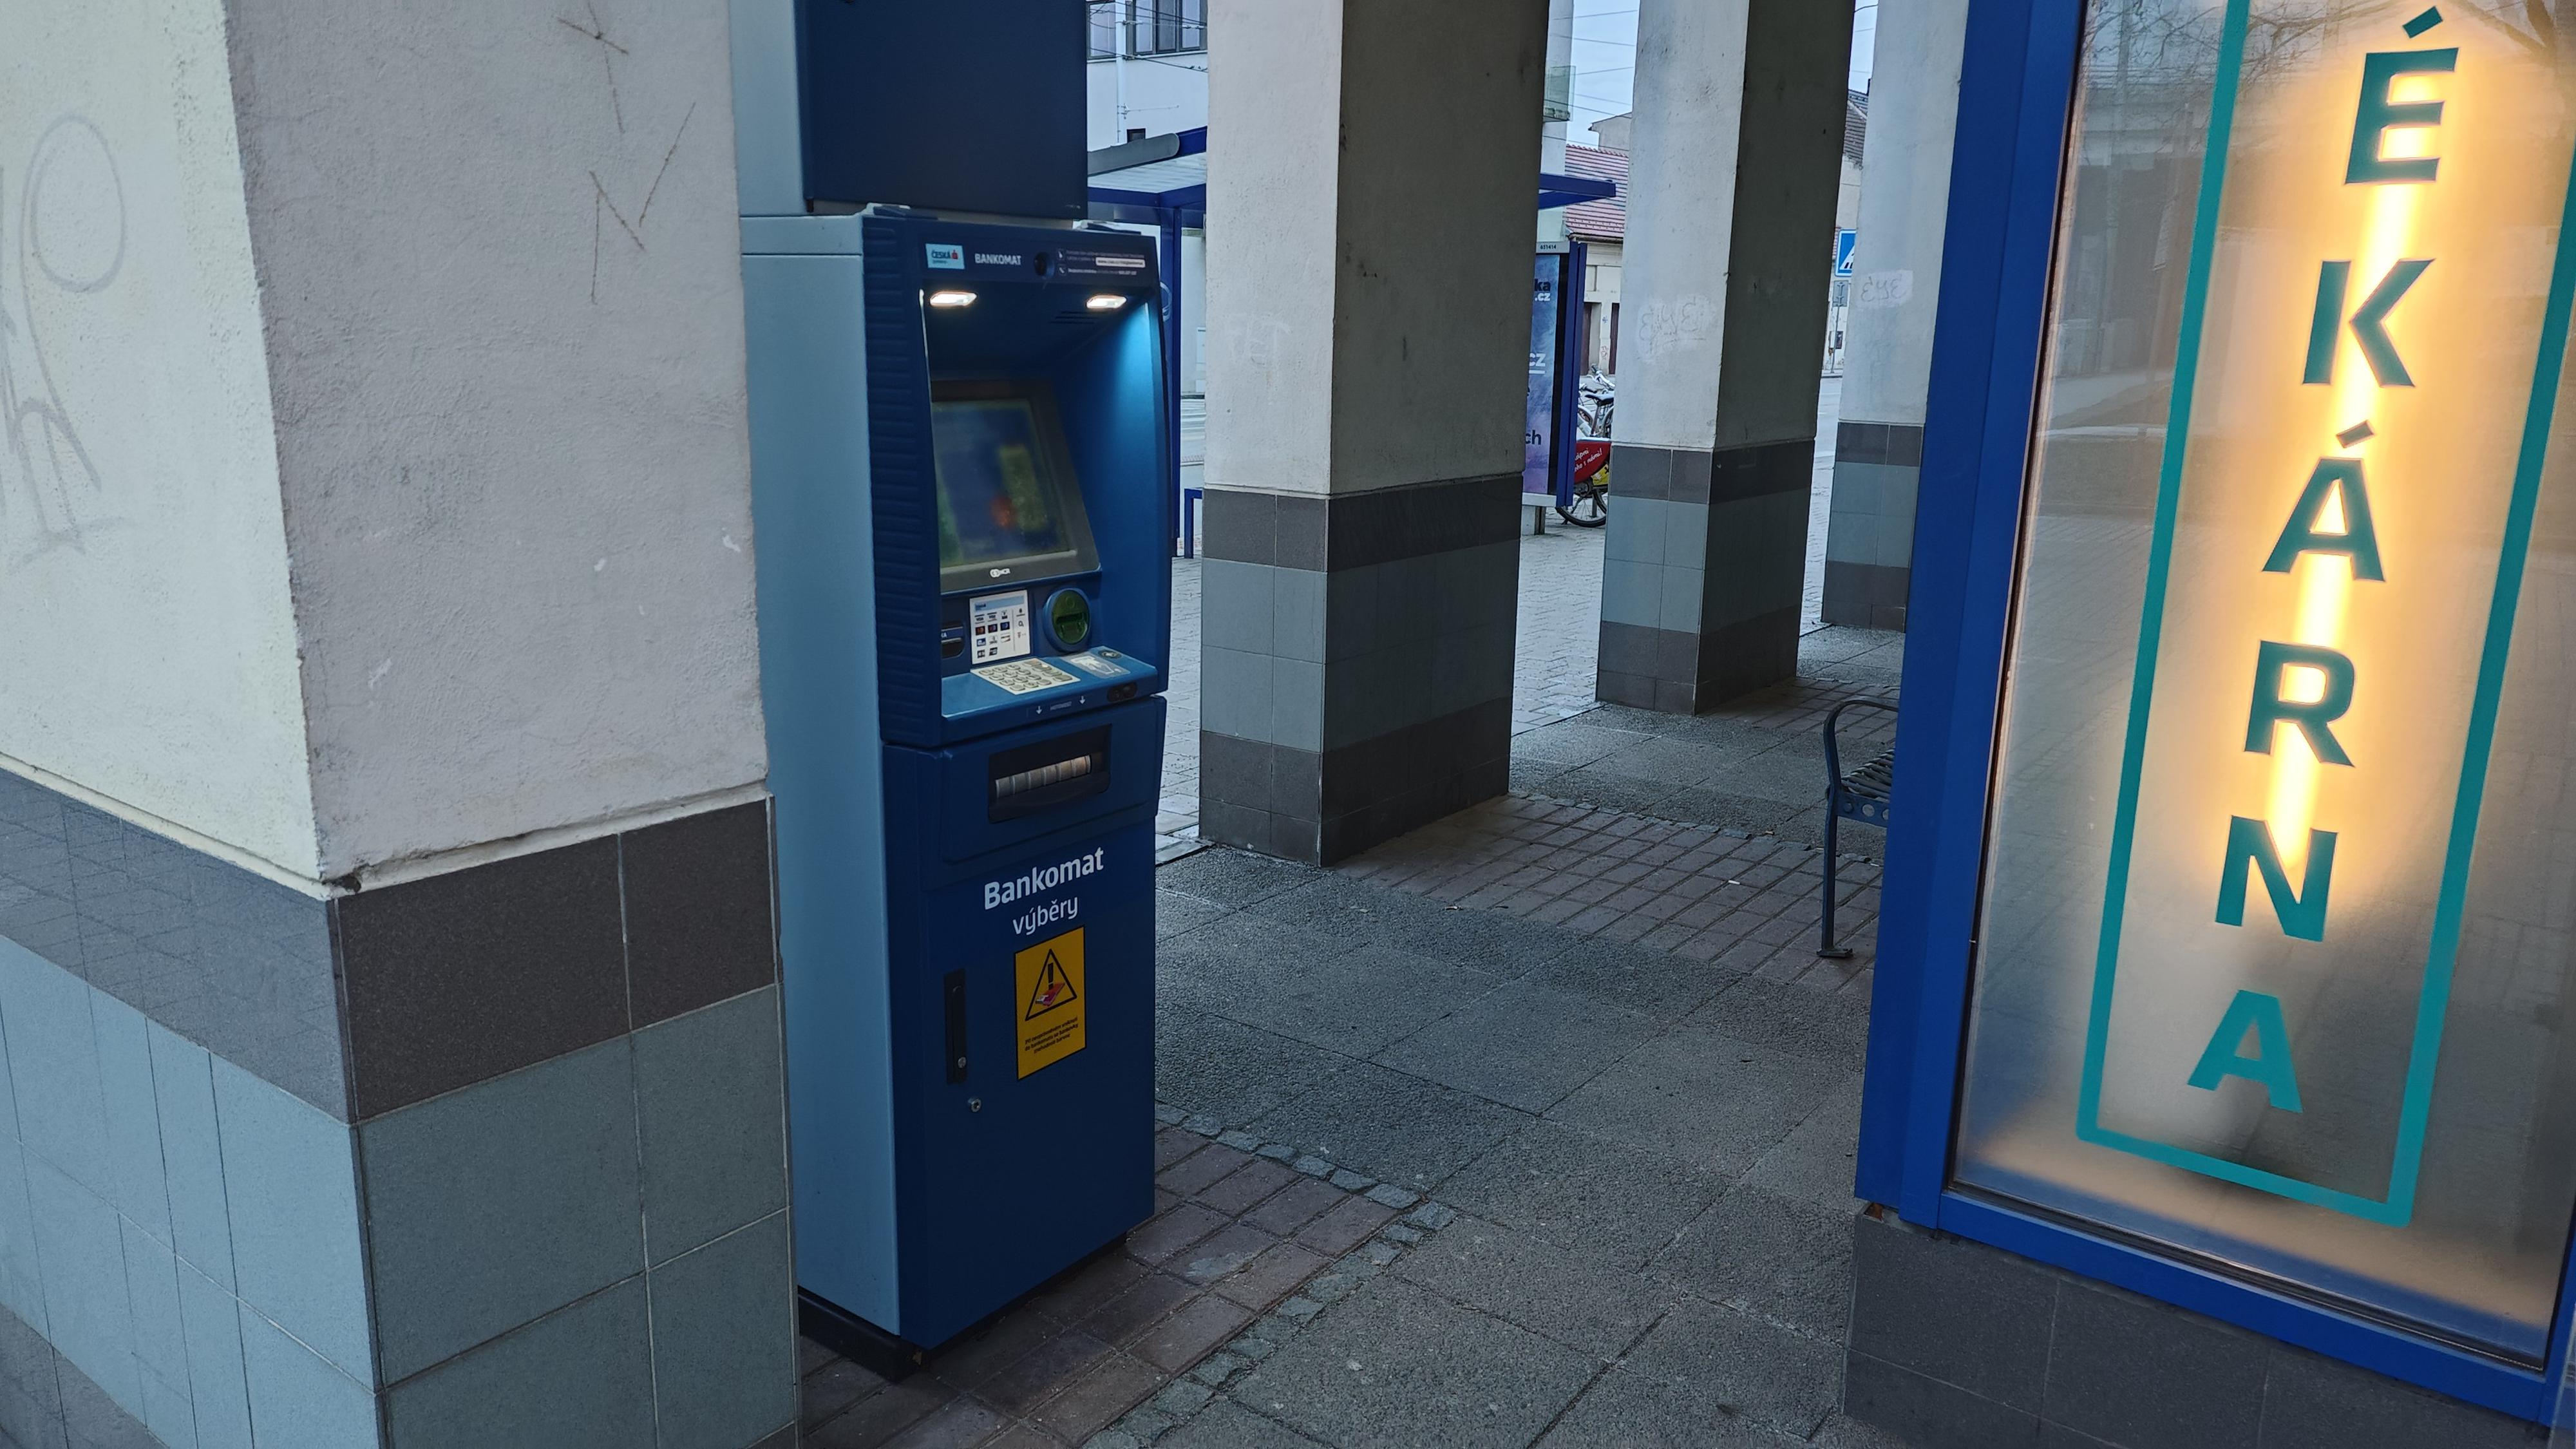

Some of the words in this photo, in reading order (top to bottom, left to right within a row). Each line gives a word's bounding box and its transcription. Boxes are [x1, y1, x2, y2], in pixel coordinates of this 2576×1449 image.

[974, 253, 1021, 265] BANKOMAT
[985, 847, 1104, 910] Bankomat
[1012, 896, 1079, 936] výběry
